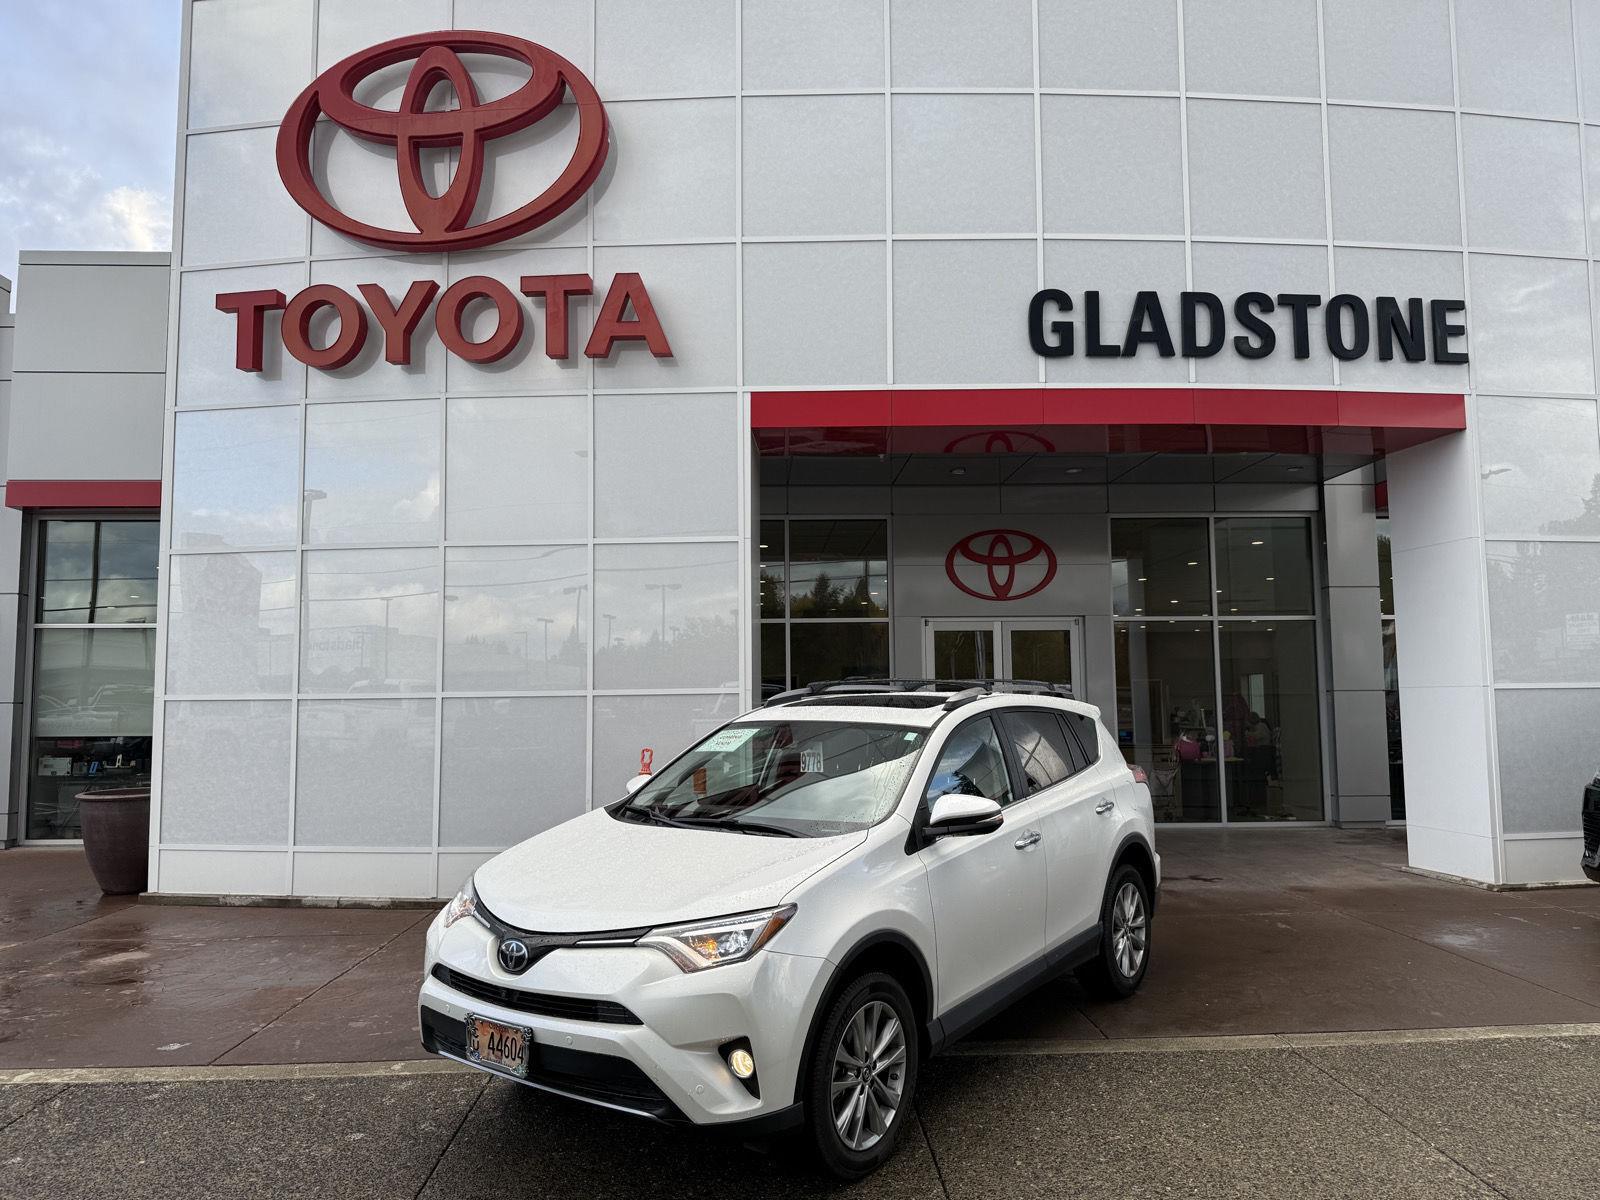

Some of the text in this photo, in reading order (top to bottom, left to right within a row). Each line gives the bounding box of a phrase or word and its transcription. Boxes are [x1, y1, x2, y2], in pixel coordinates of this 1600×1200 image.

[216, 273, 673, 372] TOYOTA
[1028, 288, 1469, 364] GLADSTONE
[801, 752, 822, 771] 9778
[488, 1031, 525, 1065] 44604
